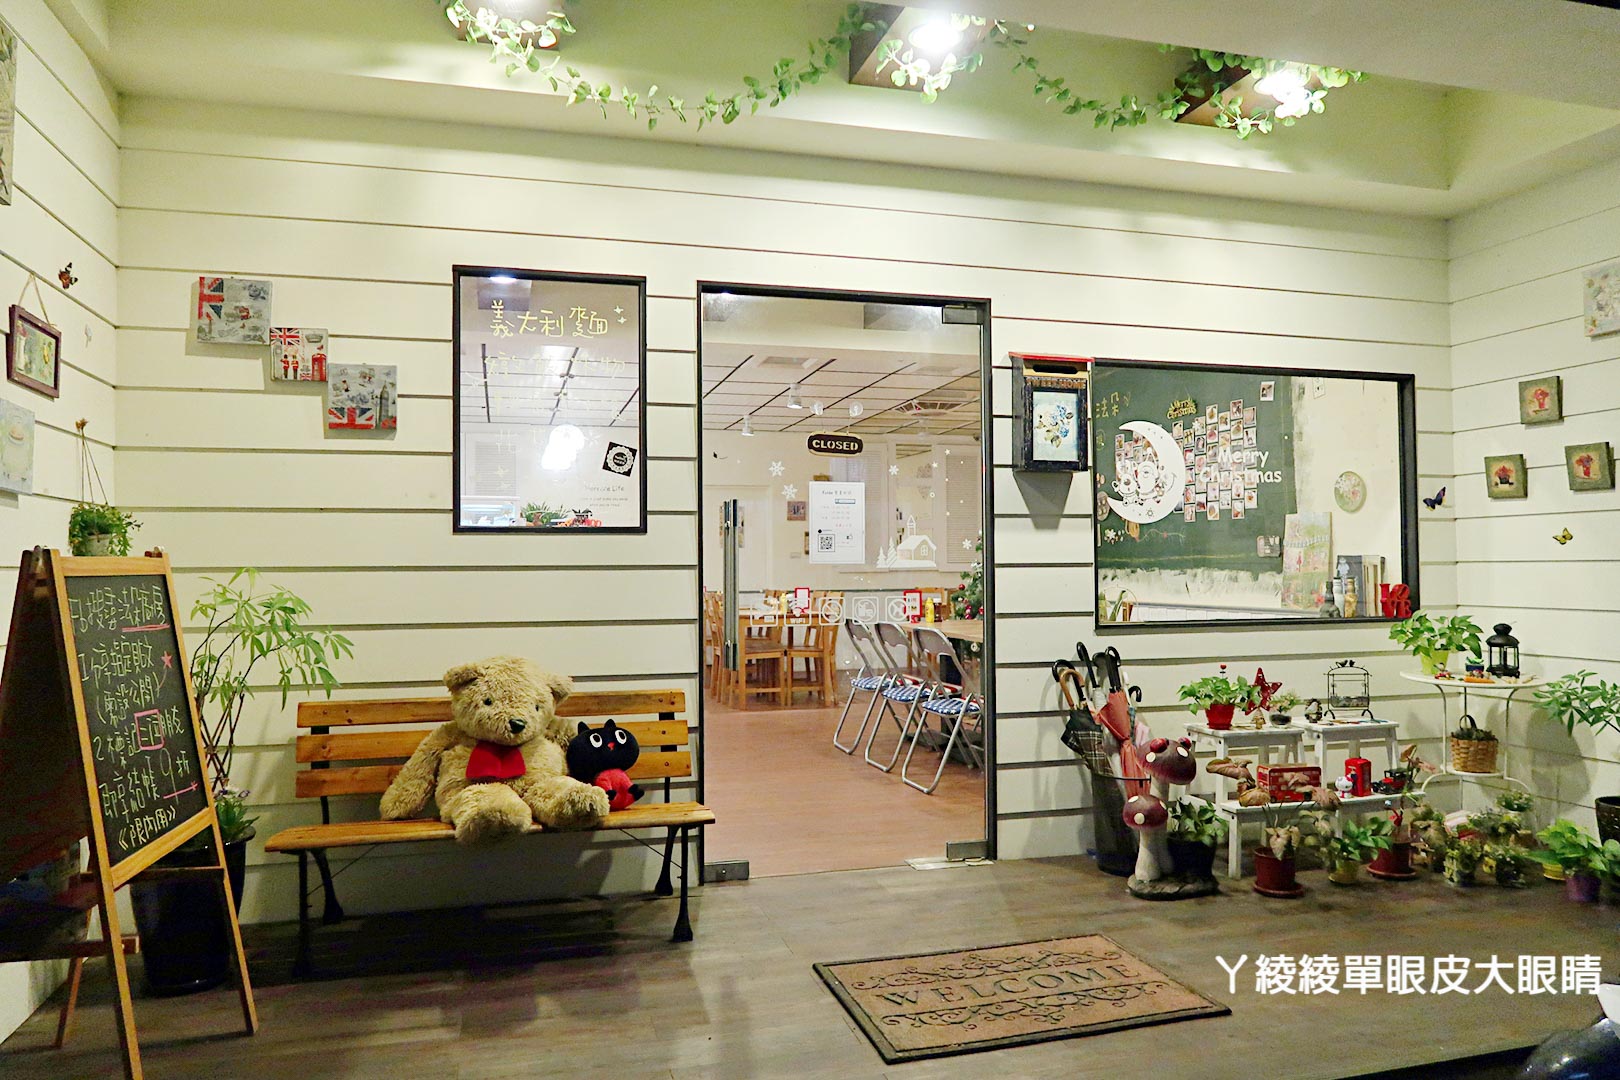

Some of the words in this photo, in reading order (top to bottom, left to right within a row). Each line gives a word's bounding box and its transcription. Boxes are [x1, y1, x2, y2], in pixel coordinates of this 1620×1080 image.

[490, 299, 608, 339] 義大利麵
[812, 439, 859, 451] CLOSED
[1218, 446, 1269, 468] Merry
[1199, 465, 1282, 483] Christmas
[874, 962, 1143, 1009] WELCOME
